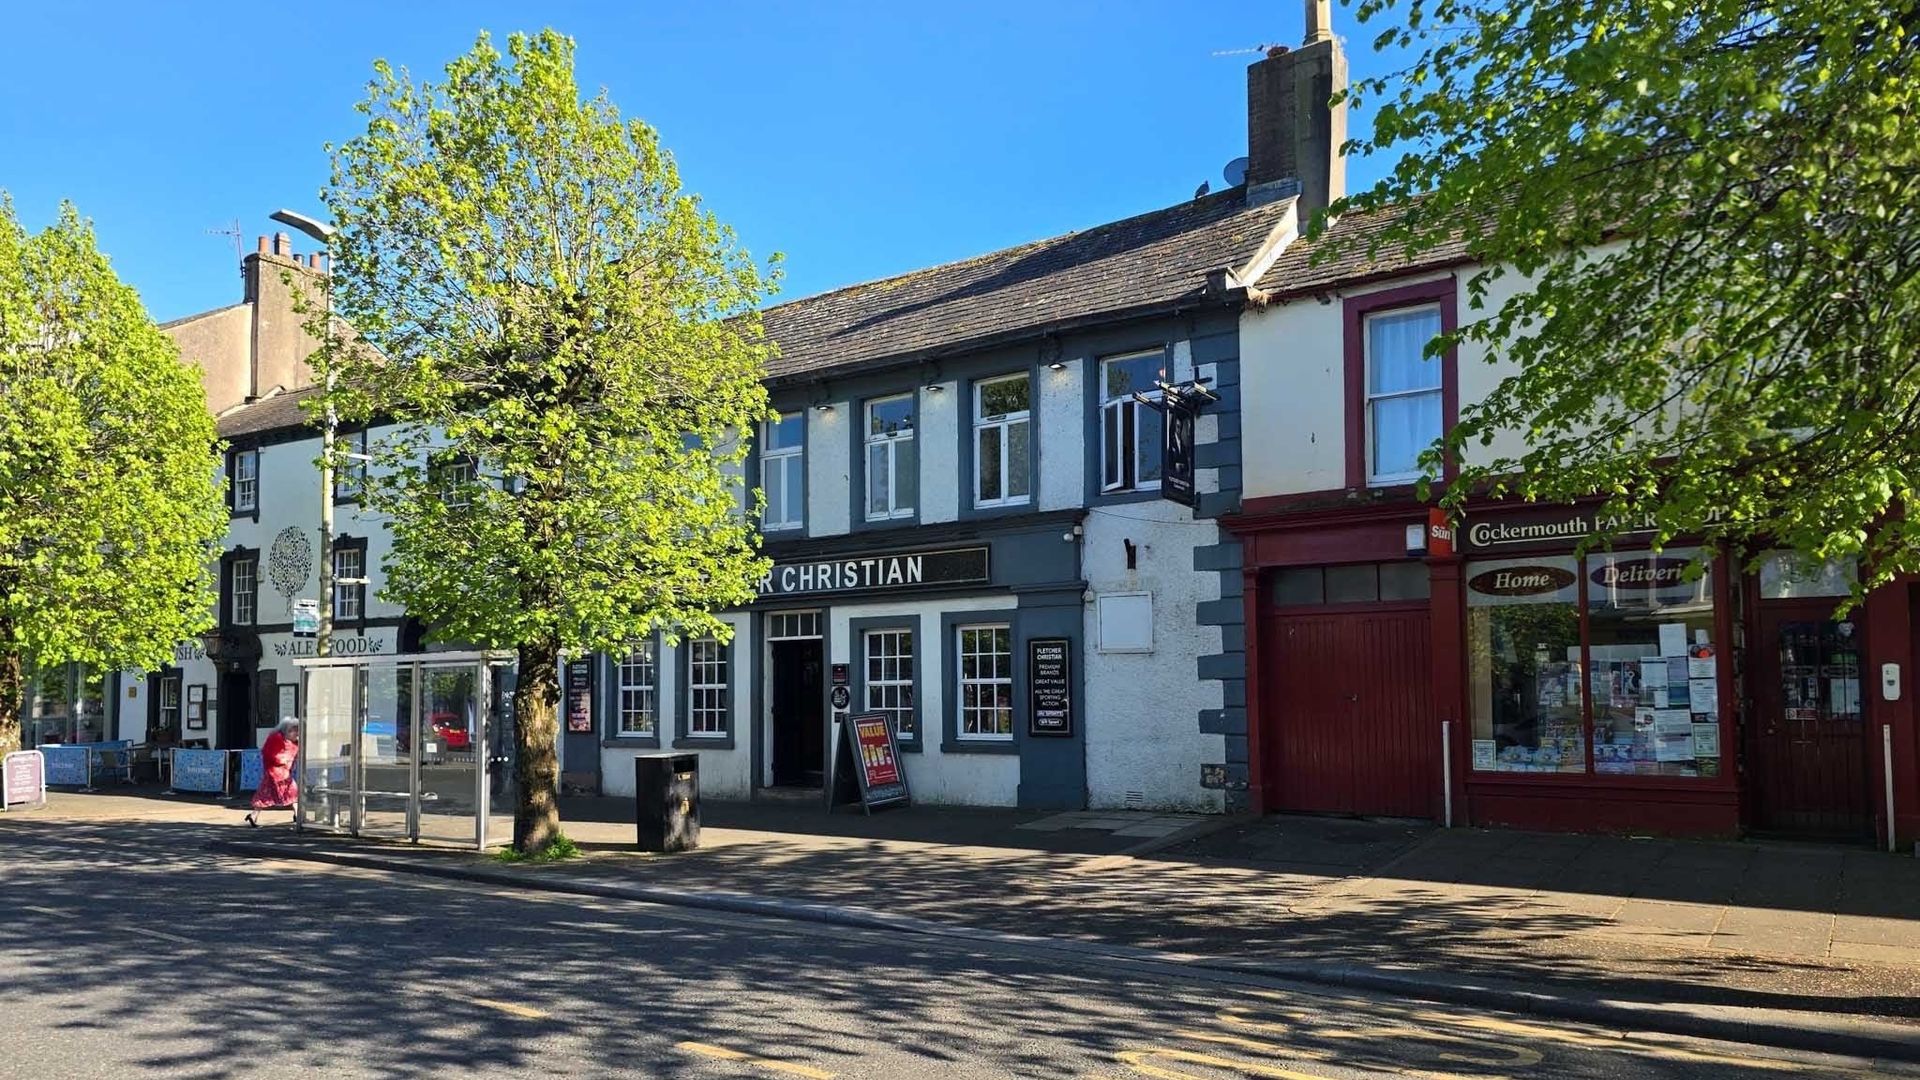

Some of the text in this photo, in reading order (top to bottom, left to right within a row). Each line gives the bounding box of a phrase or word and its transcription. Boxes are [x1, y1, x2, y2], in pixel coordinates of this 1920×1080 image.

[1470, 516, 1588, 547] Cockermouth
[781, 556, 923, 592] CHRISTIAN
[1494, 572, 1550, 590] Home
[1603, 562, 1683, 584] Deliveri
[288, 640, 313, 656] ALE
[858, 725, 886, 738] VALUE
